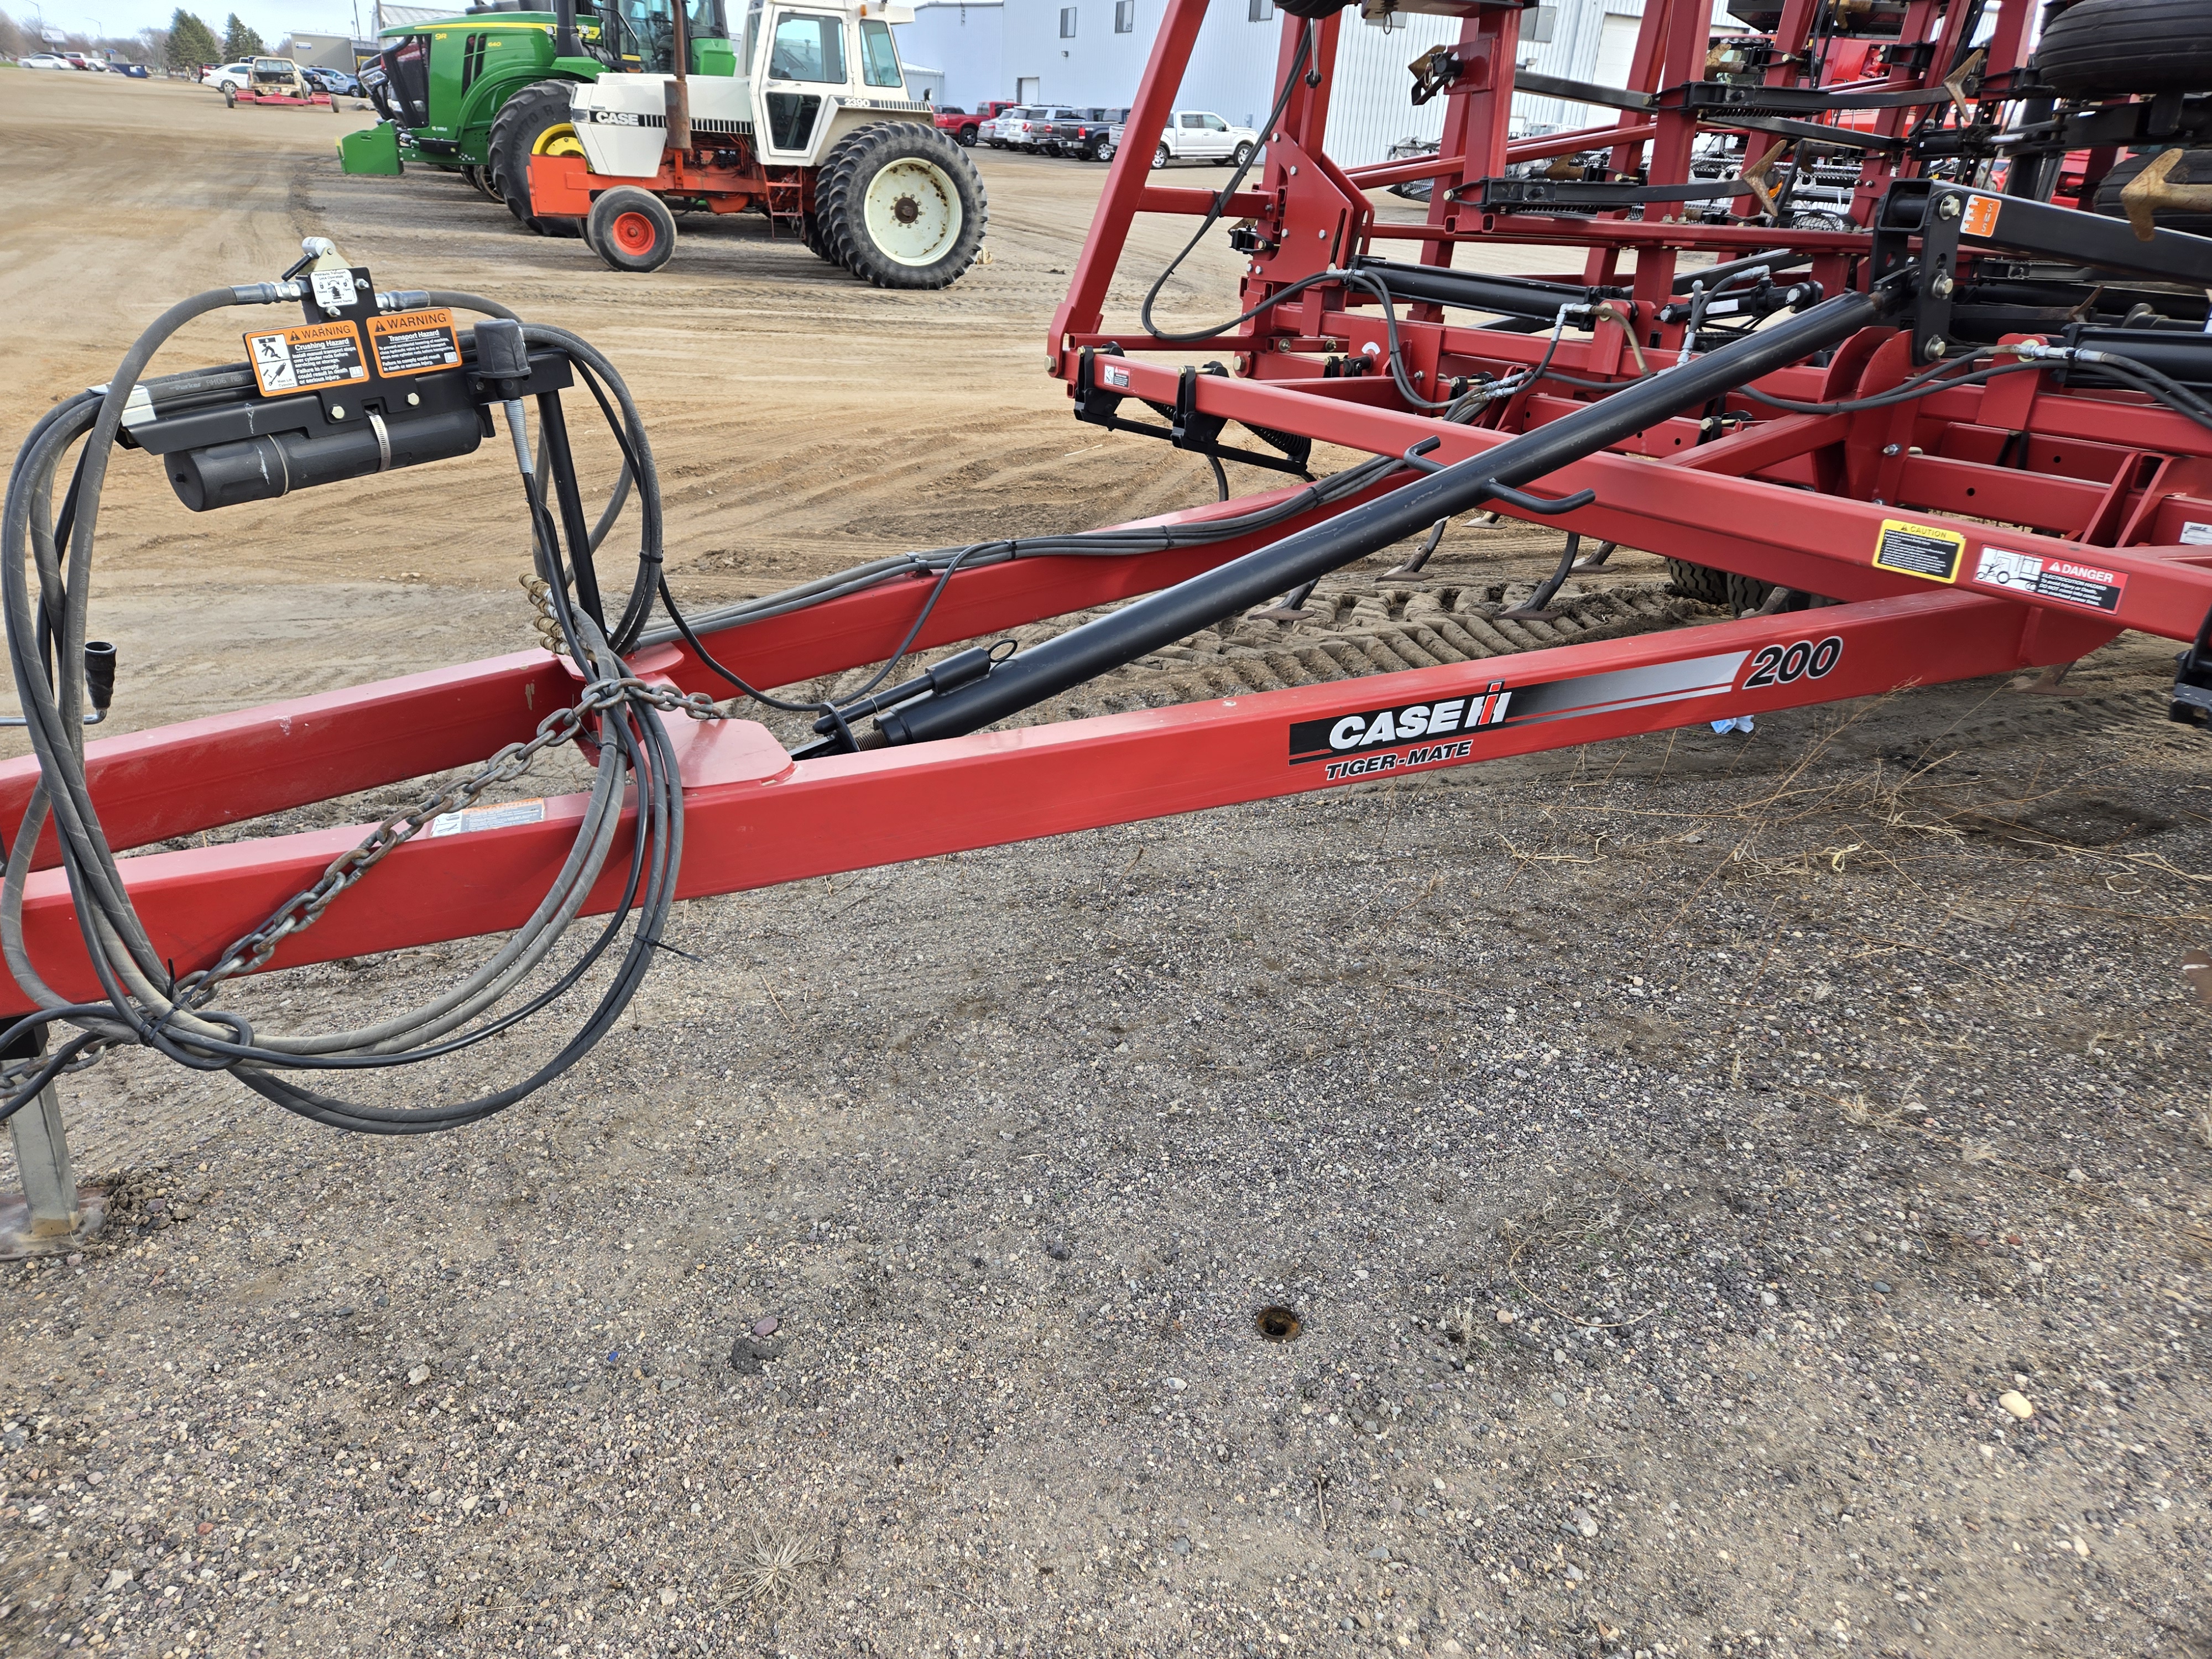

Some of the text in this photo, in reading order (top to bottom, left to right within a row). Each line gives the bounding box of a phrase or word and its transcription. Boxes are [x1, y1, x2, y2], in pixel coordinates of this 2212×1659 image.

[844, 98, 870, 107] 2390
[596, 112, 639, 126] CASE
[387, 313, 446, 328] WARNING
[301, 325, 351, 338] WARNING
[388, 329, 440, 342] Transport Hazard
[295, 338, 350, 351] Crushing Hazard
[1910, 526, 1947, 538] CAUTION
[2062, 564, 2114, 583] DANGER
[2042, 573, 2107, 591] ELECTROCUTION HAZARD
[2048, 591, 2071, 599] overhead
[2083, 593, 2102, 601] contact
[1742, 635, 1843, 690] 200
[1329, 699, 1465, 749] CASE
[1325, 739, 1474, 780] TIGER-MATE
[479, 800, 539, 811] WARNING
